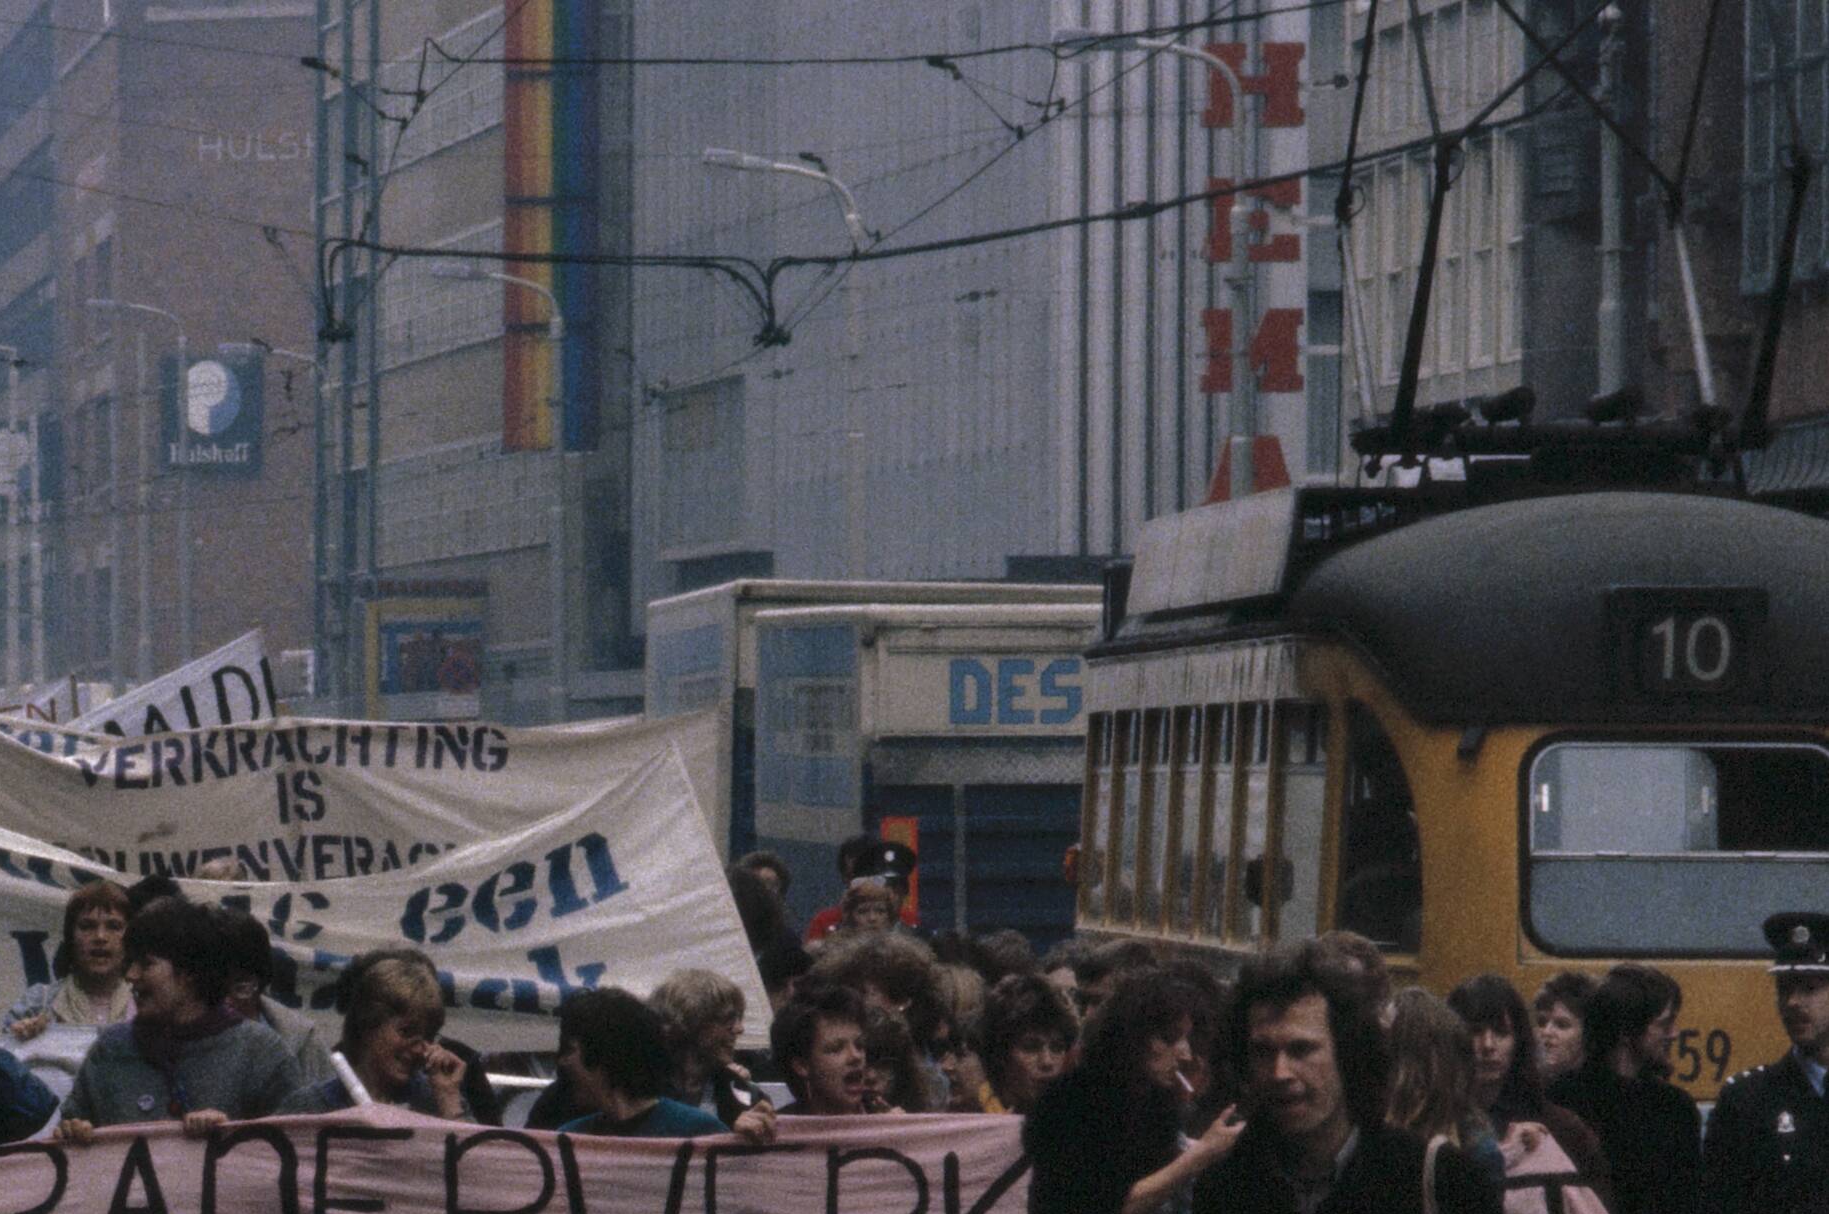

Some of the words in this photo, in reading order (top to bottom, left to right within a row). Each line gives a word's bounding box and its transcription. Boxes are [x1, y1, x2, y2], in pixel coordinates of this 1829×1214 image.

[1201, 41, 1305, 505] HEMA
[1652, 616, 1731, 683] 10
[275, 770, 326, 824] IS
[400, 832, 630, 943] een
